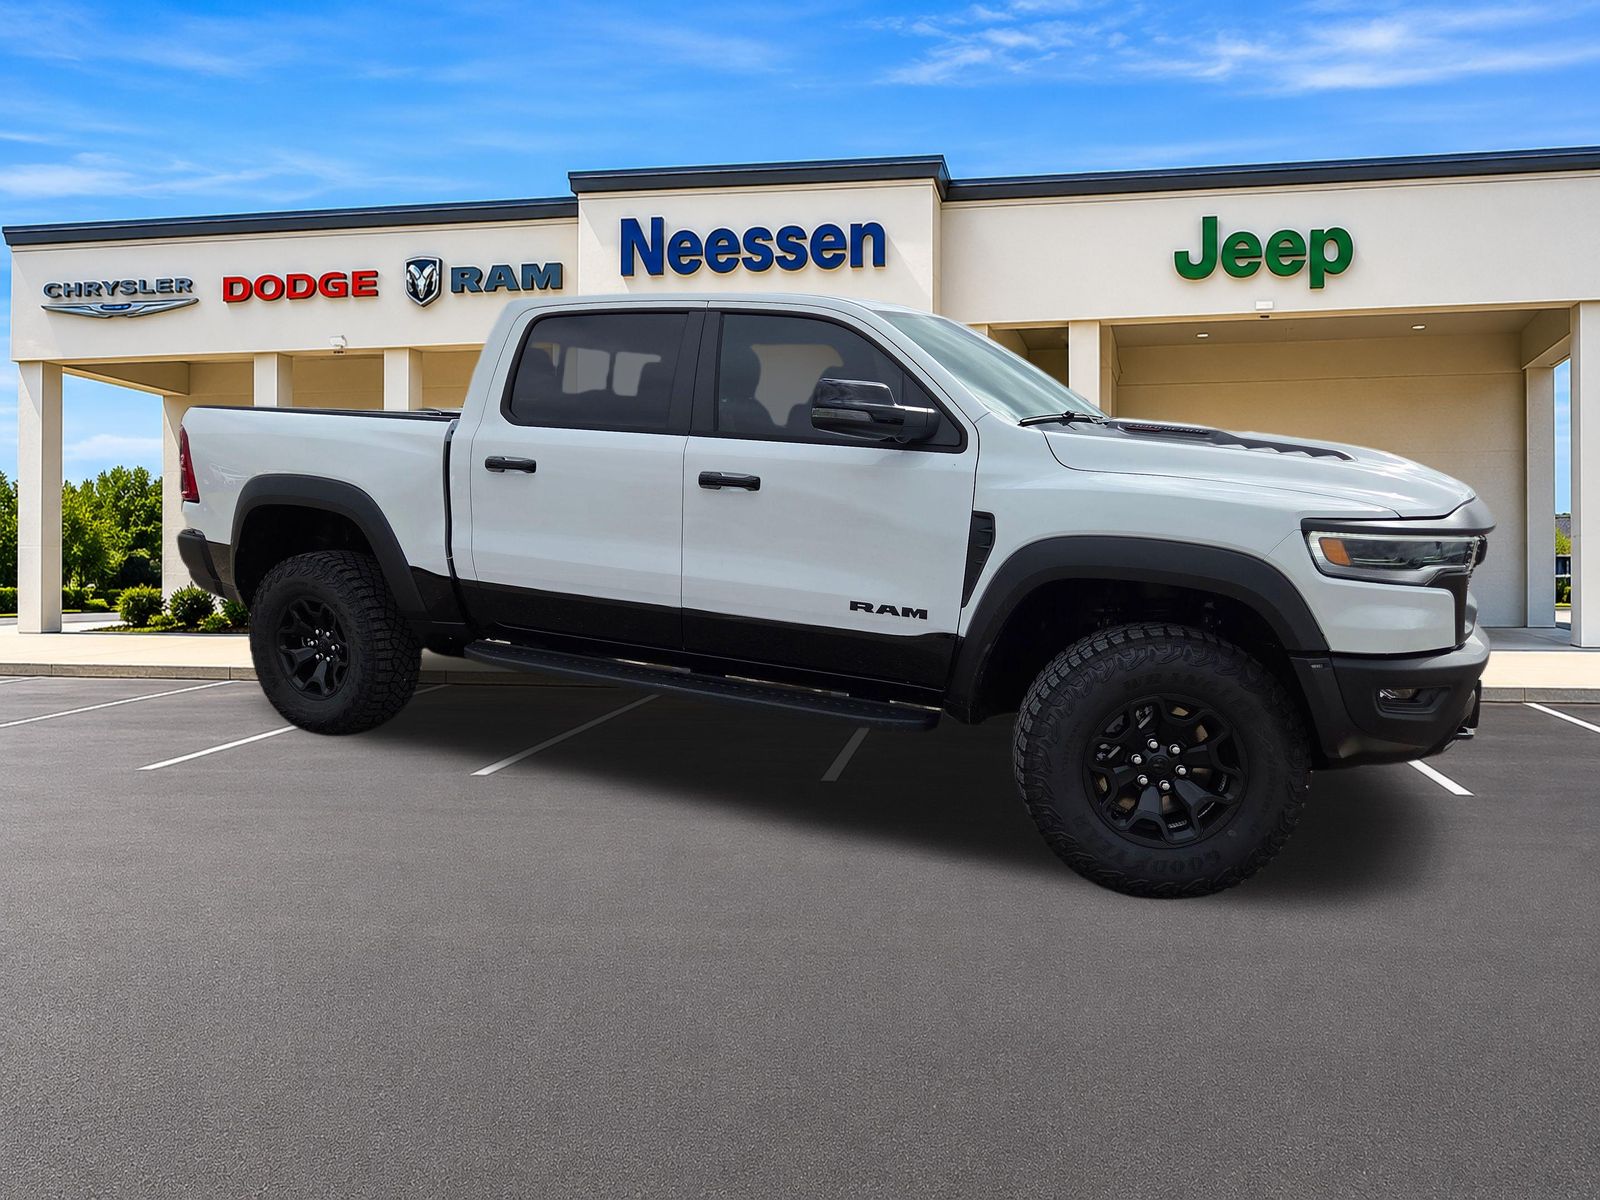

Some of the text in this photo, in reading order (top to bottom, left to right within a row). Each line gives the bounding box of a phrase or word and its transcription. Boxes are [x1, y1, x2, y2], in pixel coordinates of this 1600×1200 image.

[620, 216, 887, 277] Neessen
[1174, 215, 1354, 288] Jeep
[43, 277, 194, 299] CHRYSLER
[222, 270, 379, 302] DODGE
[451, 262, 564, 294] RAM
[849, 600, 928, 620] RAM
